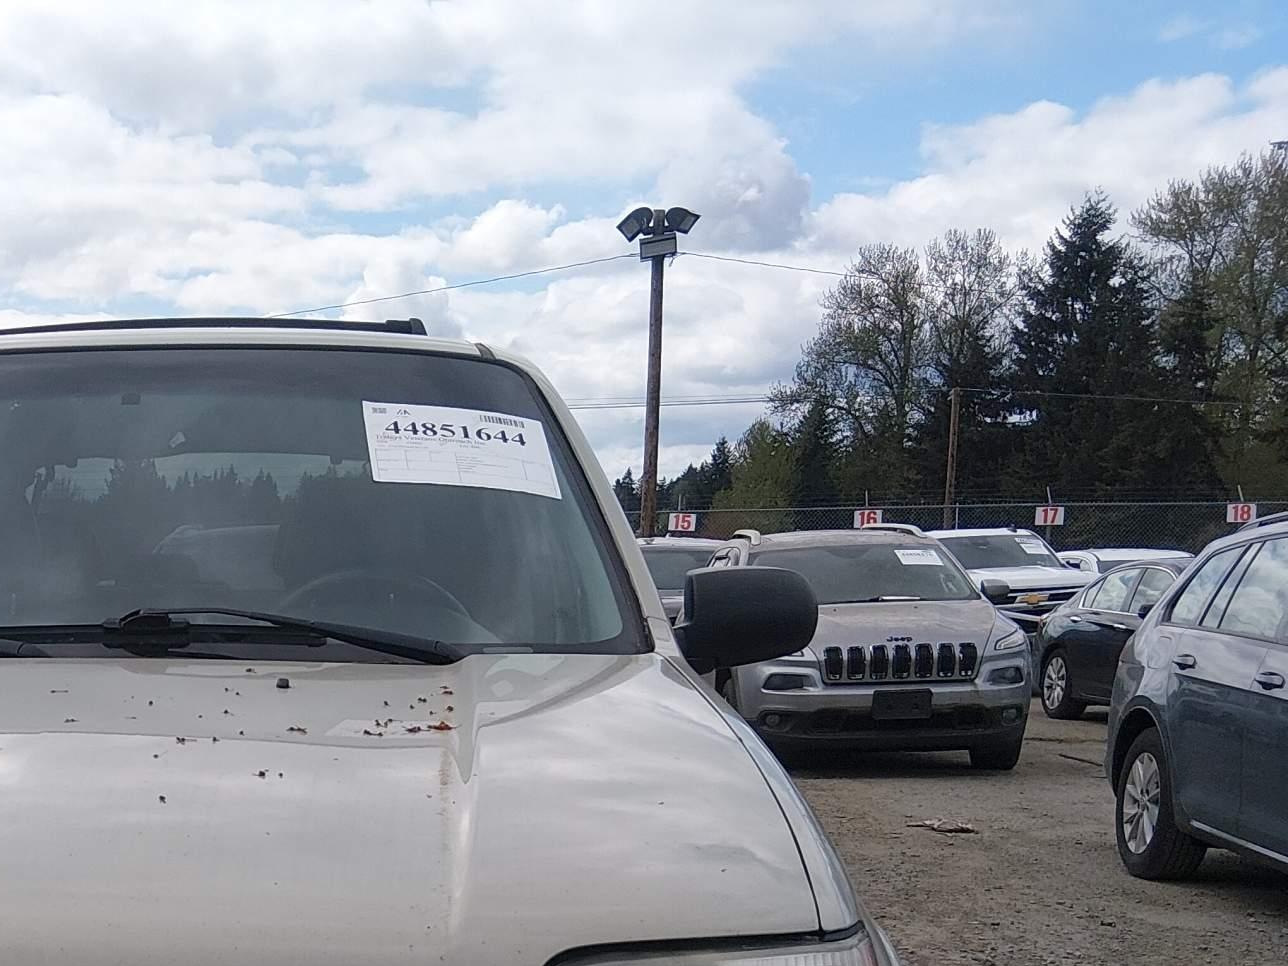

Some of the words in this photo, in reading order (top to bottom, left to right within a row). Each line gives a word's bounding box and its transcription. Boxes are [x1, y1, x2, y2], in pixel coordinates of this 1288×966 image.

[385, 420, 527, 446] 44851644
[859, 511, 877, 527] 16
[1042, 508, 1059, 524] 17
[1232, 504, 1251, 521] 18
[673, 515, 691, 530] 15
